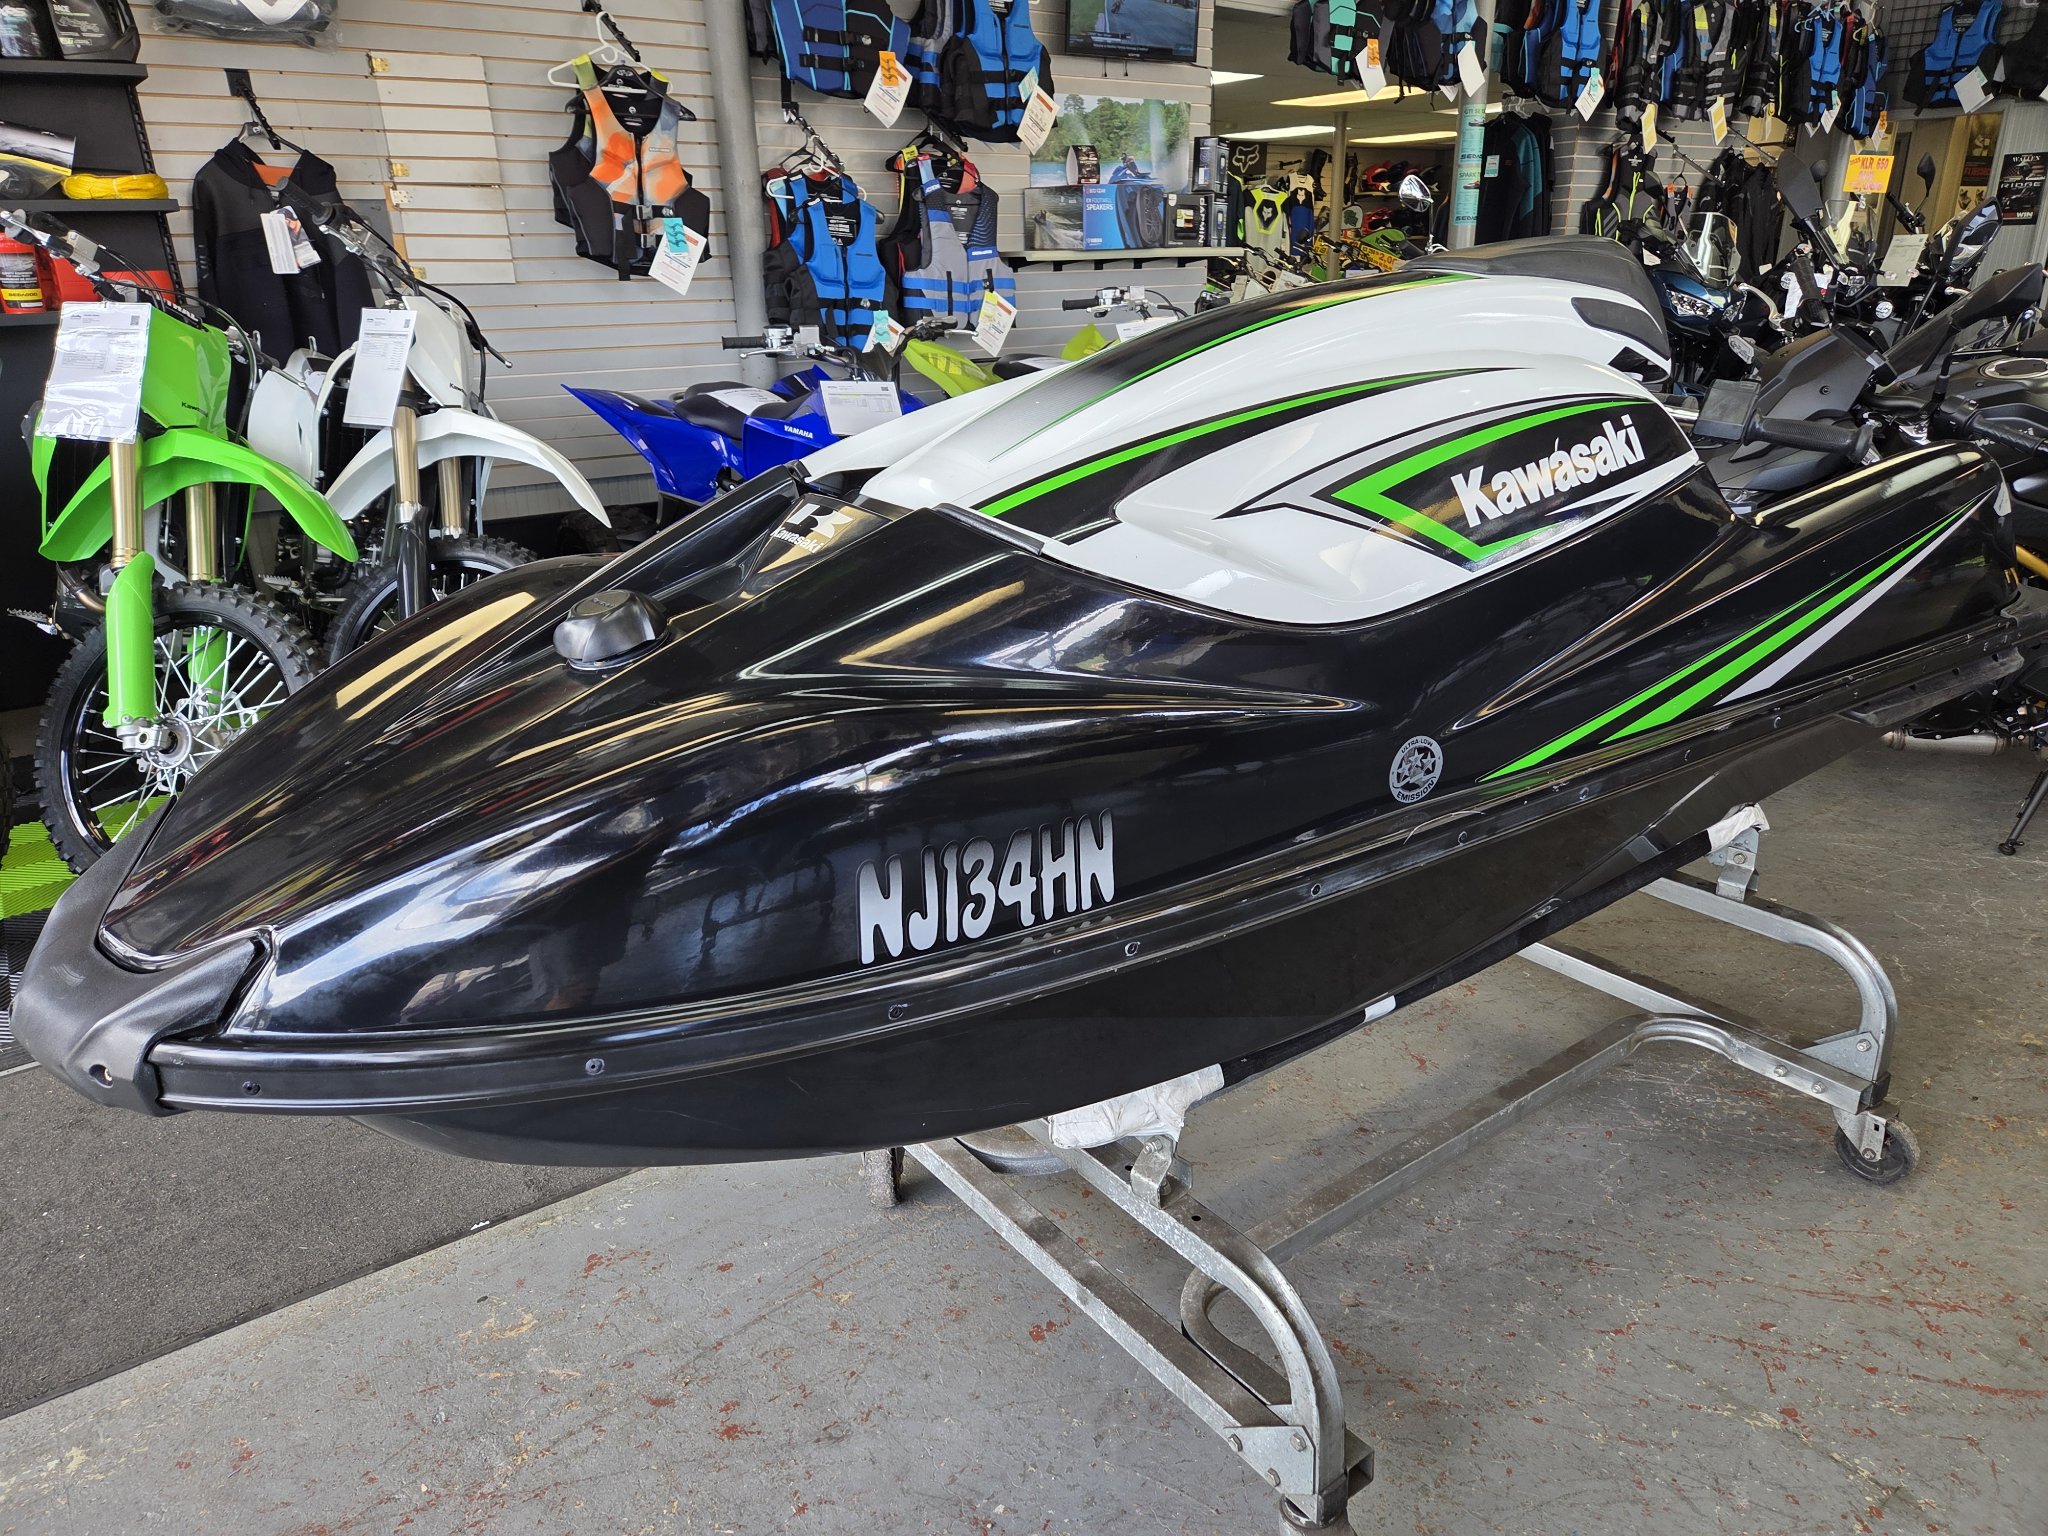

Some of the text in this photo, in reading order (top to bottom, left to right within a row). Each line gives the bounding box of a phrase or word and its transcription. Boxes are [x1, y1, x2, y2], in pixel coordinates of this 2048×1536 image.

[1198, 197, 1208, 244] GARMIN
[784, 425, 814, 439] YAMAHA
[1451, 414, 1645, 528] Kawasaki
[770, 527, 824, 553] Kawasaki
[1396, 780, 1435, 801] EMISSION
[857, 808, 1115, 966] NJ134HN
